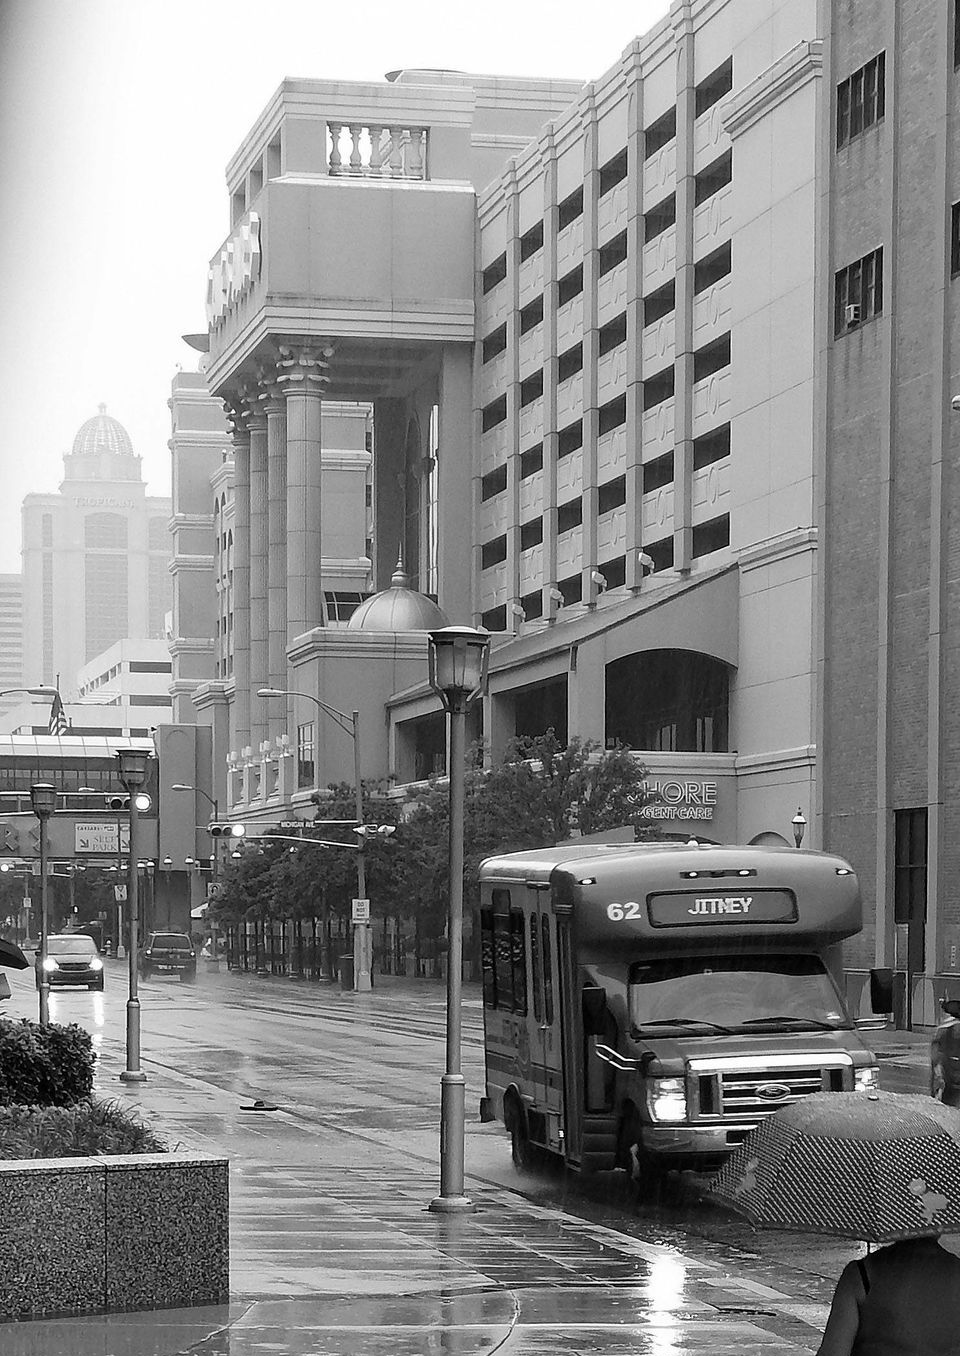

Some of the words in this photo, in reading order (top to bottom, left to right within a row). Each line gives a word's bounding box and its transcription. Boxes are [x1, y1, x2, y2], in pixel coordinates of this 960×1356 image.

[678, 807, 713, 819] CARE
[607, 902, 641, 921] 62
[688, 897, 752, 914] JITNEY
